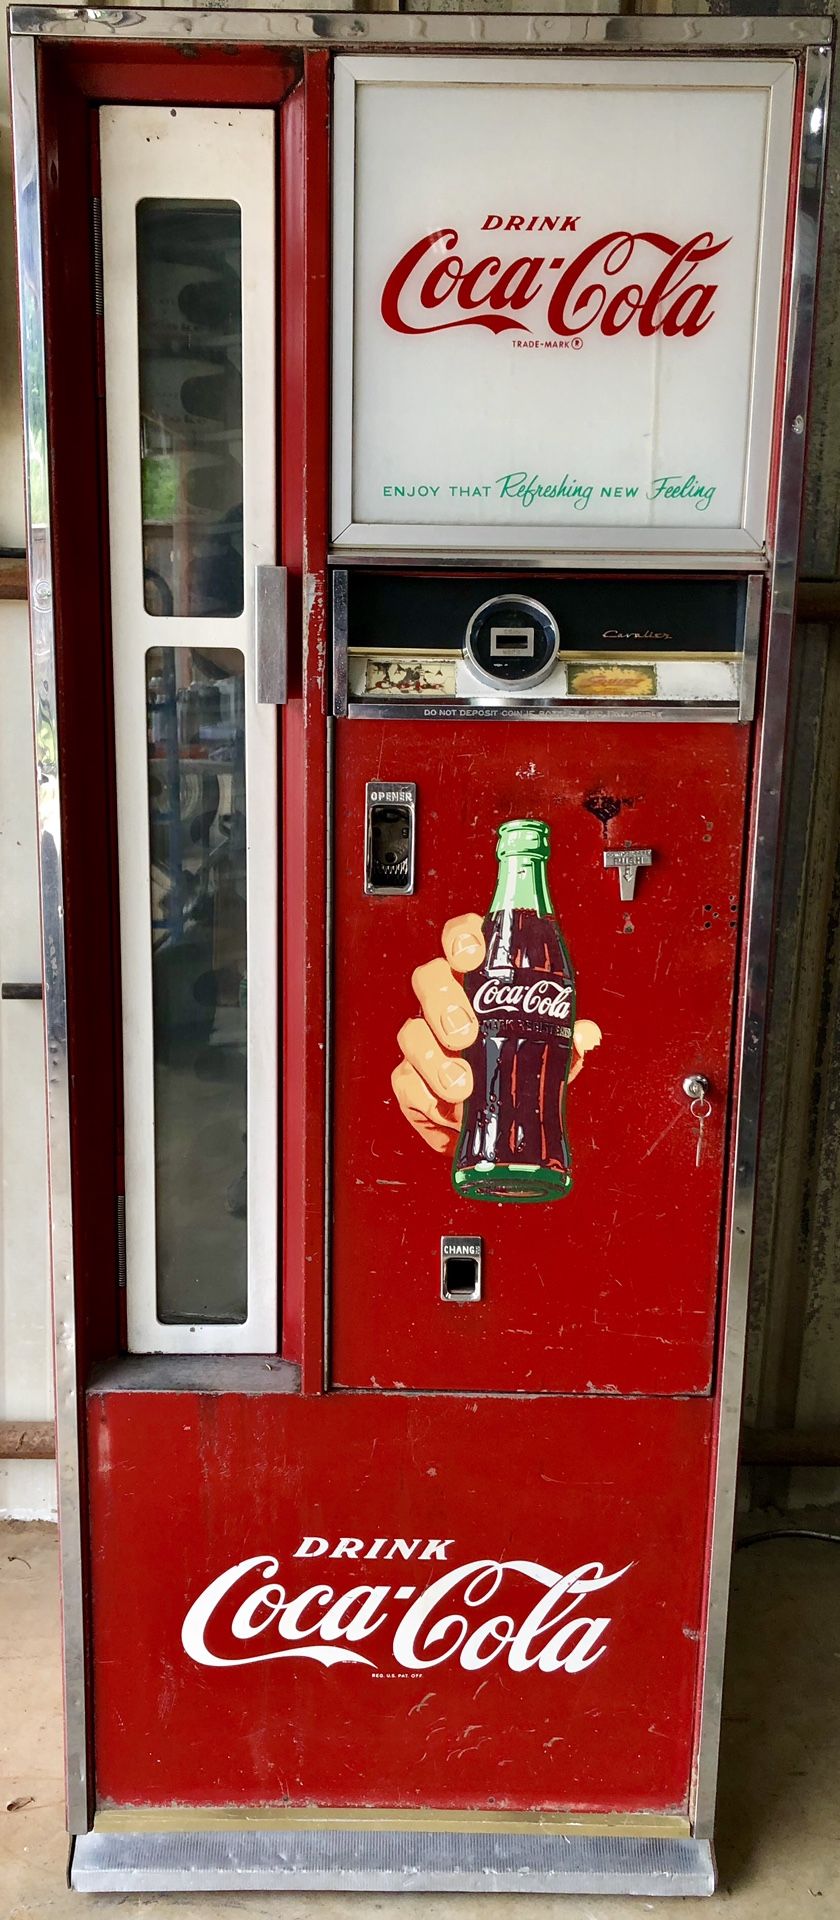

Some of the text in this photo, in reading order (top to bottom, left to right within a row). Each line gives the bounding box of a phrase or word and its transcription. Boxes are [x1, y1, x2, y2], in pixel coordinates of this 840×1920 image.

[481, 214, 582, 232] DRINK
[381, 228, 734, 337] Coca-Cola
[383, 472, 717, 511] ENJOY THAT Refreshing NEW Feeling
[602, 629, 673, 640] Cavalier
[459, 709, 498, 717] DEPOSIT
[371, 791, 412, 801] OPENER
[473, 978, 573, 1019] Coca-Cola
[293, 1536, 455, 1560] DRINK
[181, 1555, 640, 1673] Coca-Cola
